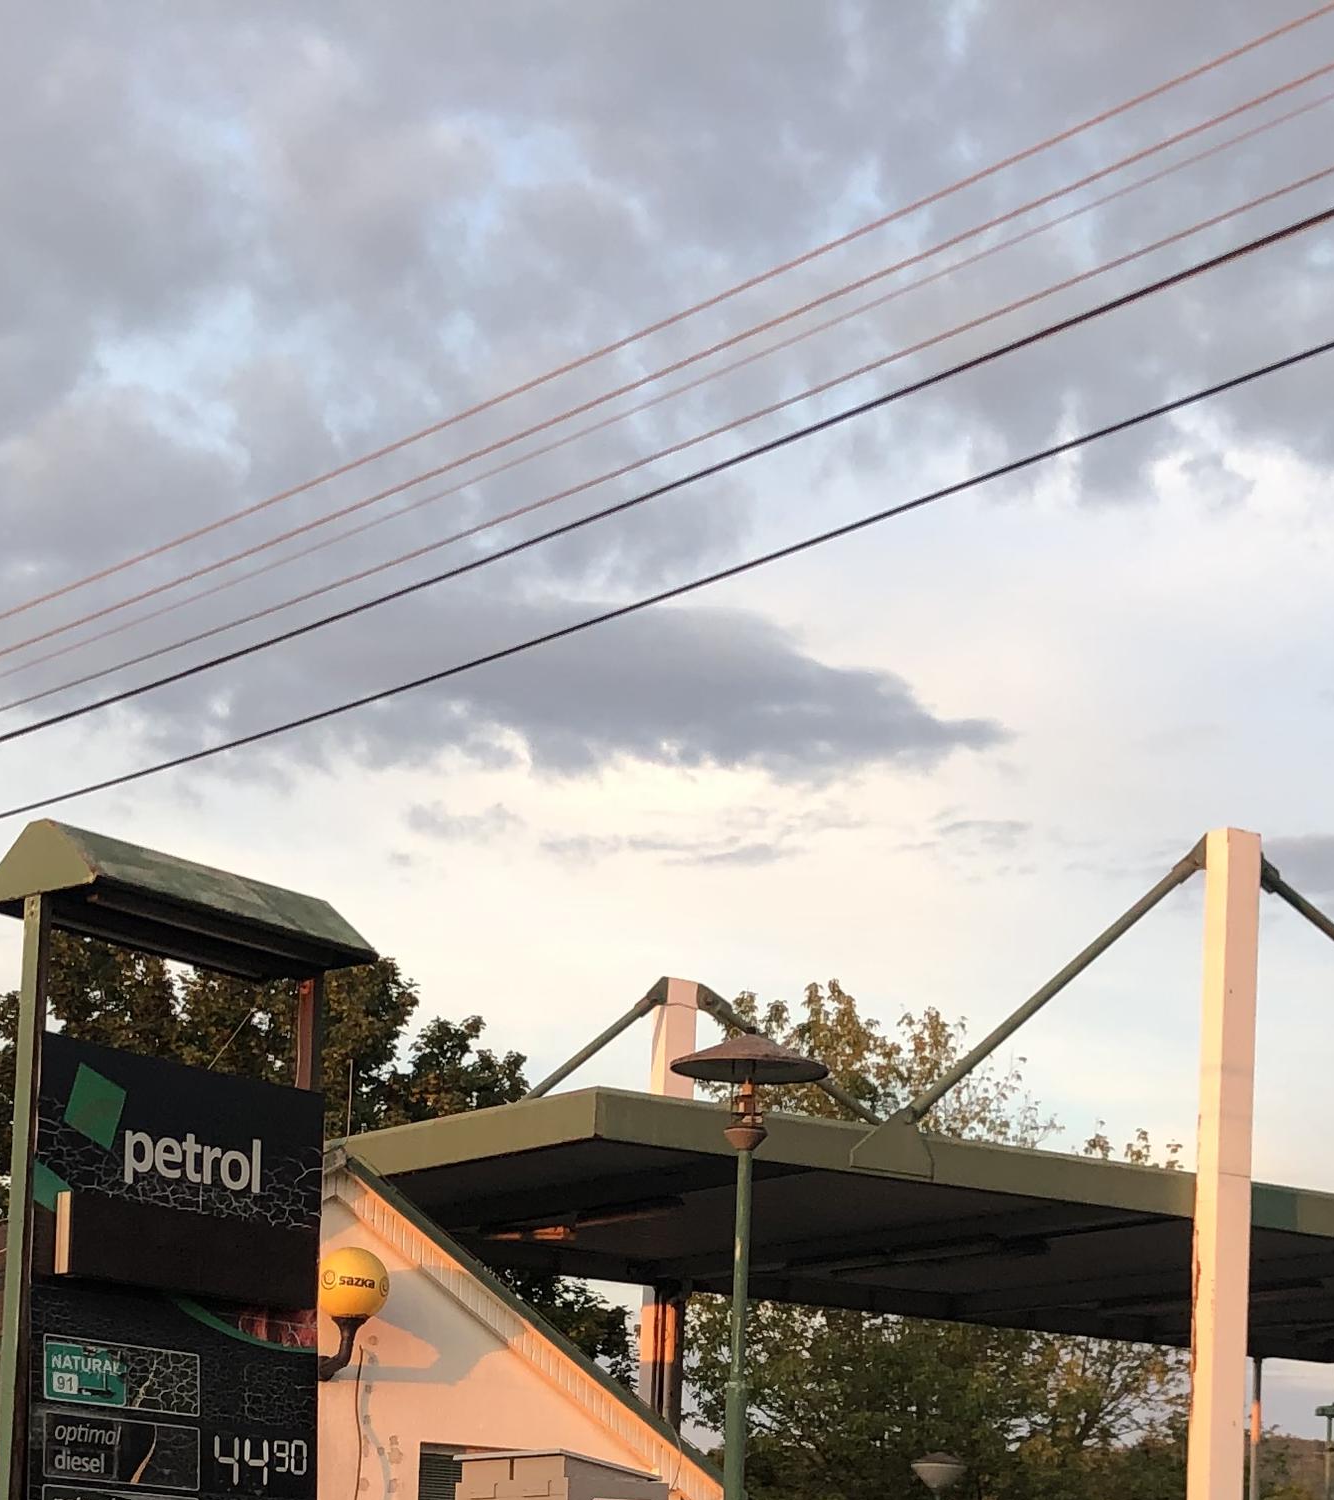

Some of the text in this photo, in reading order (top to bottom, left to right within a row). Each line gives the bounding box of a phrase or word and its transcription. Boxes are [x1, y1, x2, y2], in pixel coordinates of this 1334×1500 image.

[123, 1130, 262, 1194] petrol
[57, 1375, 74, 1392] 91
[54, 1423, 121, 1446] optimal
[54, 1451, 105, 1473] diesel
